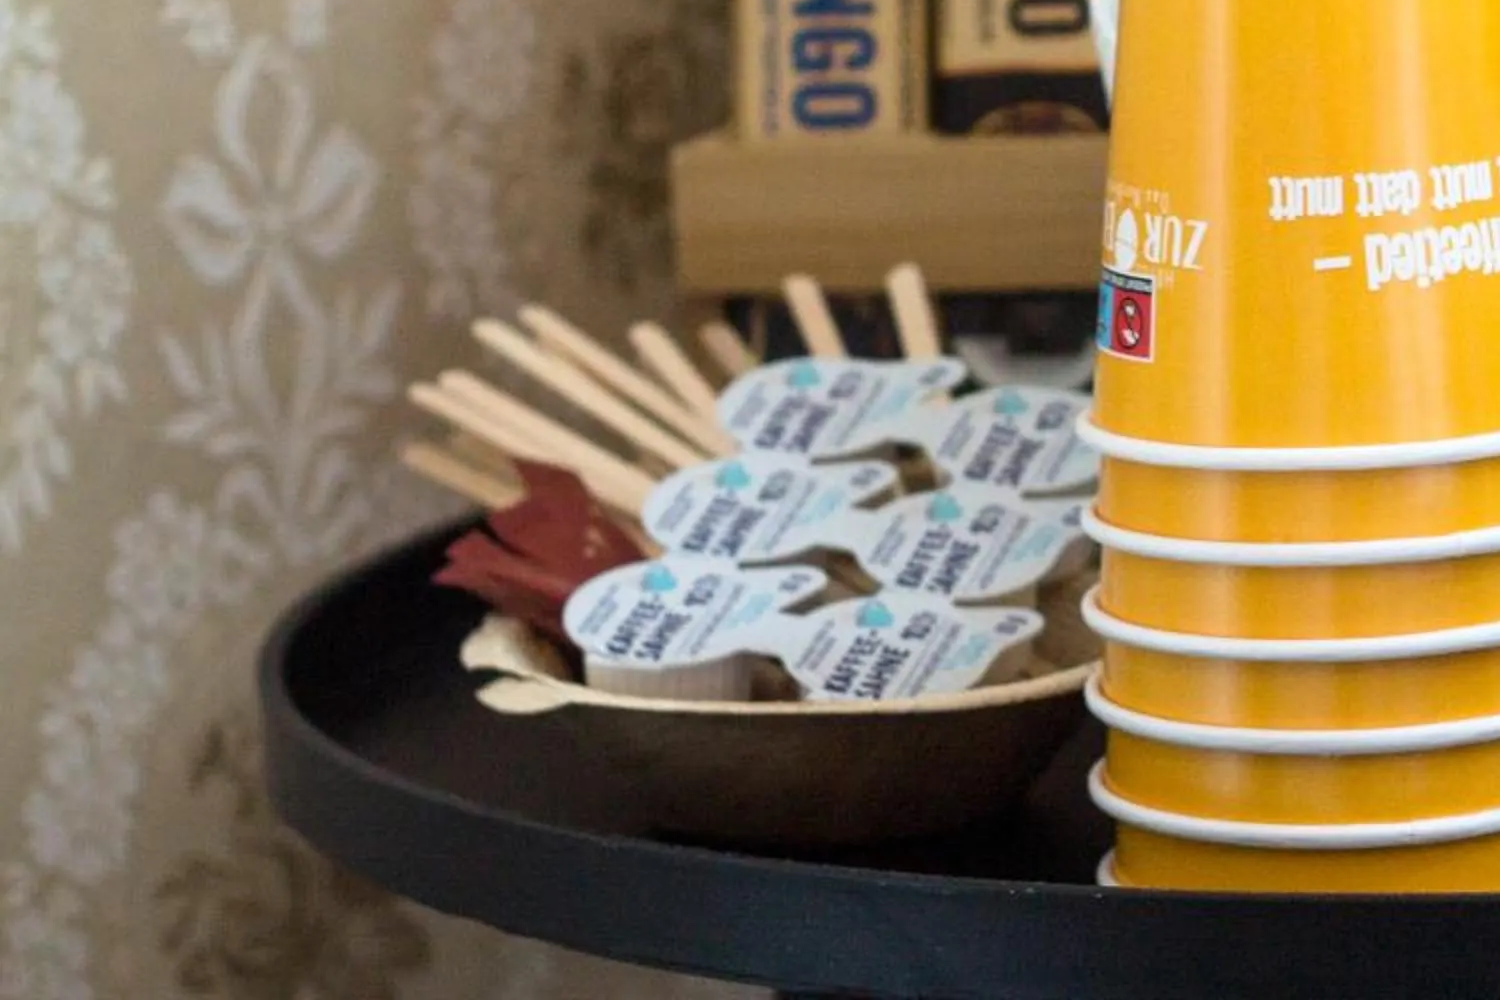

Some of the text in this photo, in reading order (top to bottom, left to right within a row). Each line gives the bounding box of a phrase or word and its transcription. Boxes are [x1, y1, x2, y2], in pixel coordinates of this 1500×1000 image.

[1268, 175, 1344, 220] mutt
[1354, 169, 1421, 217] datt
[1430, 161, 1493, 210] mutt
[1144, 211, 1208, 272] ZUR
